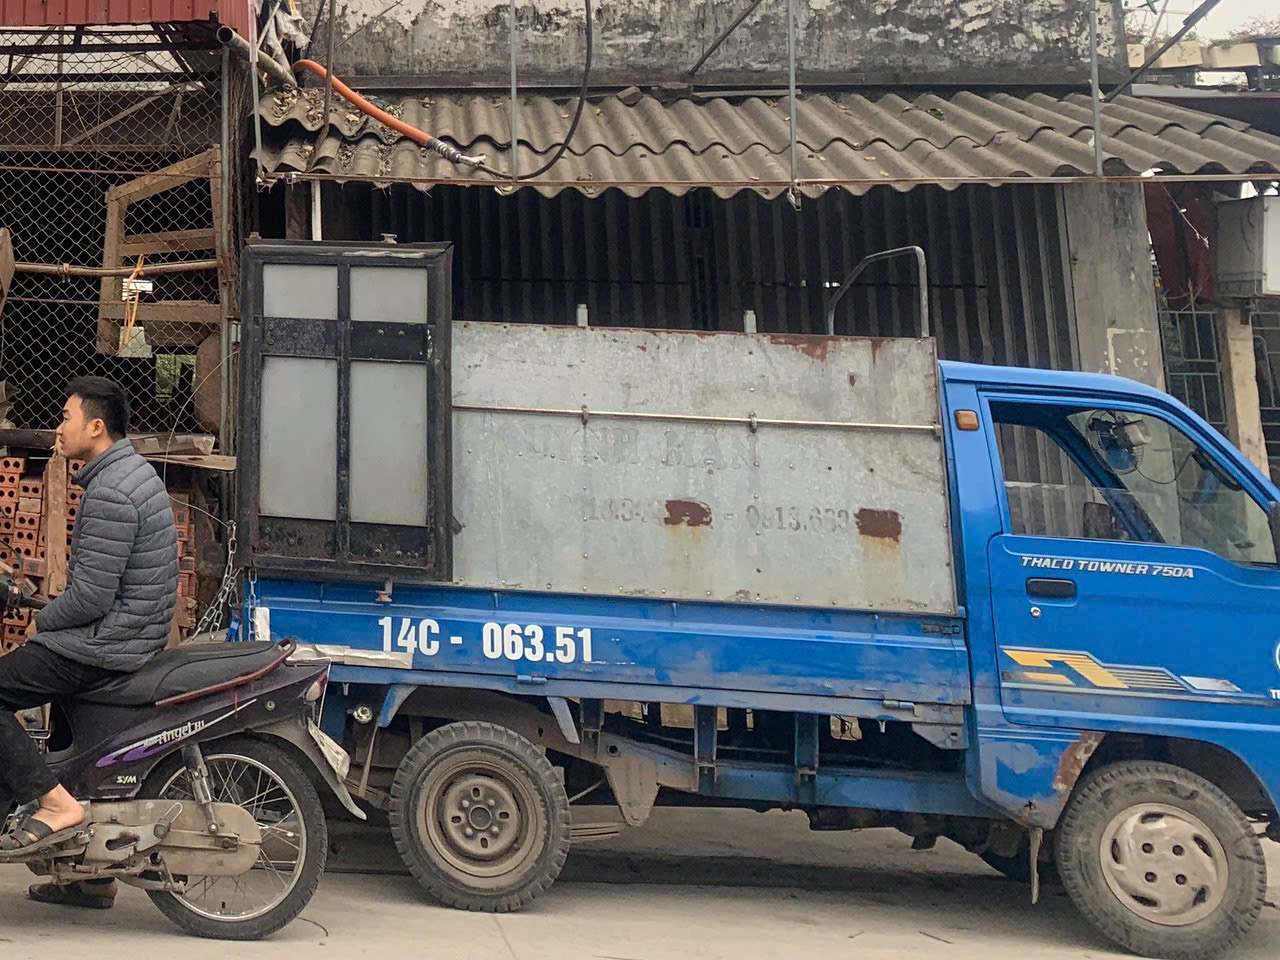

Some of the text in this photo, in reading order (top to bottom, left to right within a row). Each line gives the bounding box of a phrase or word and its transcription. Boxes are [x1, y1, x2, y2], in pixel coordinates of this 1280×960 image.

[1021, 556, 1195, 579] THACO TOWNER 750A
[378, 617, 439, 656] 14C
[483, 622, 592, 663] 063.51
[116, 775, 137, 784] SYM
